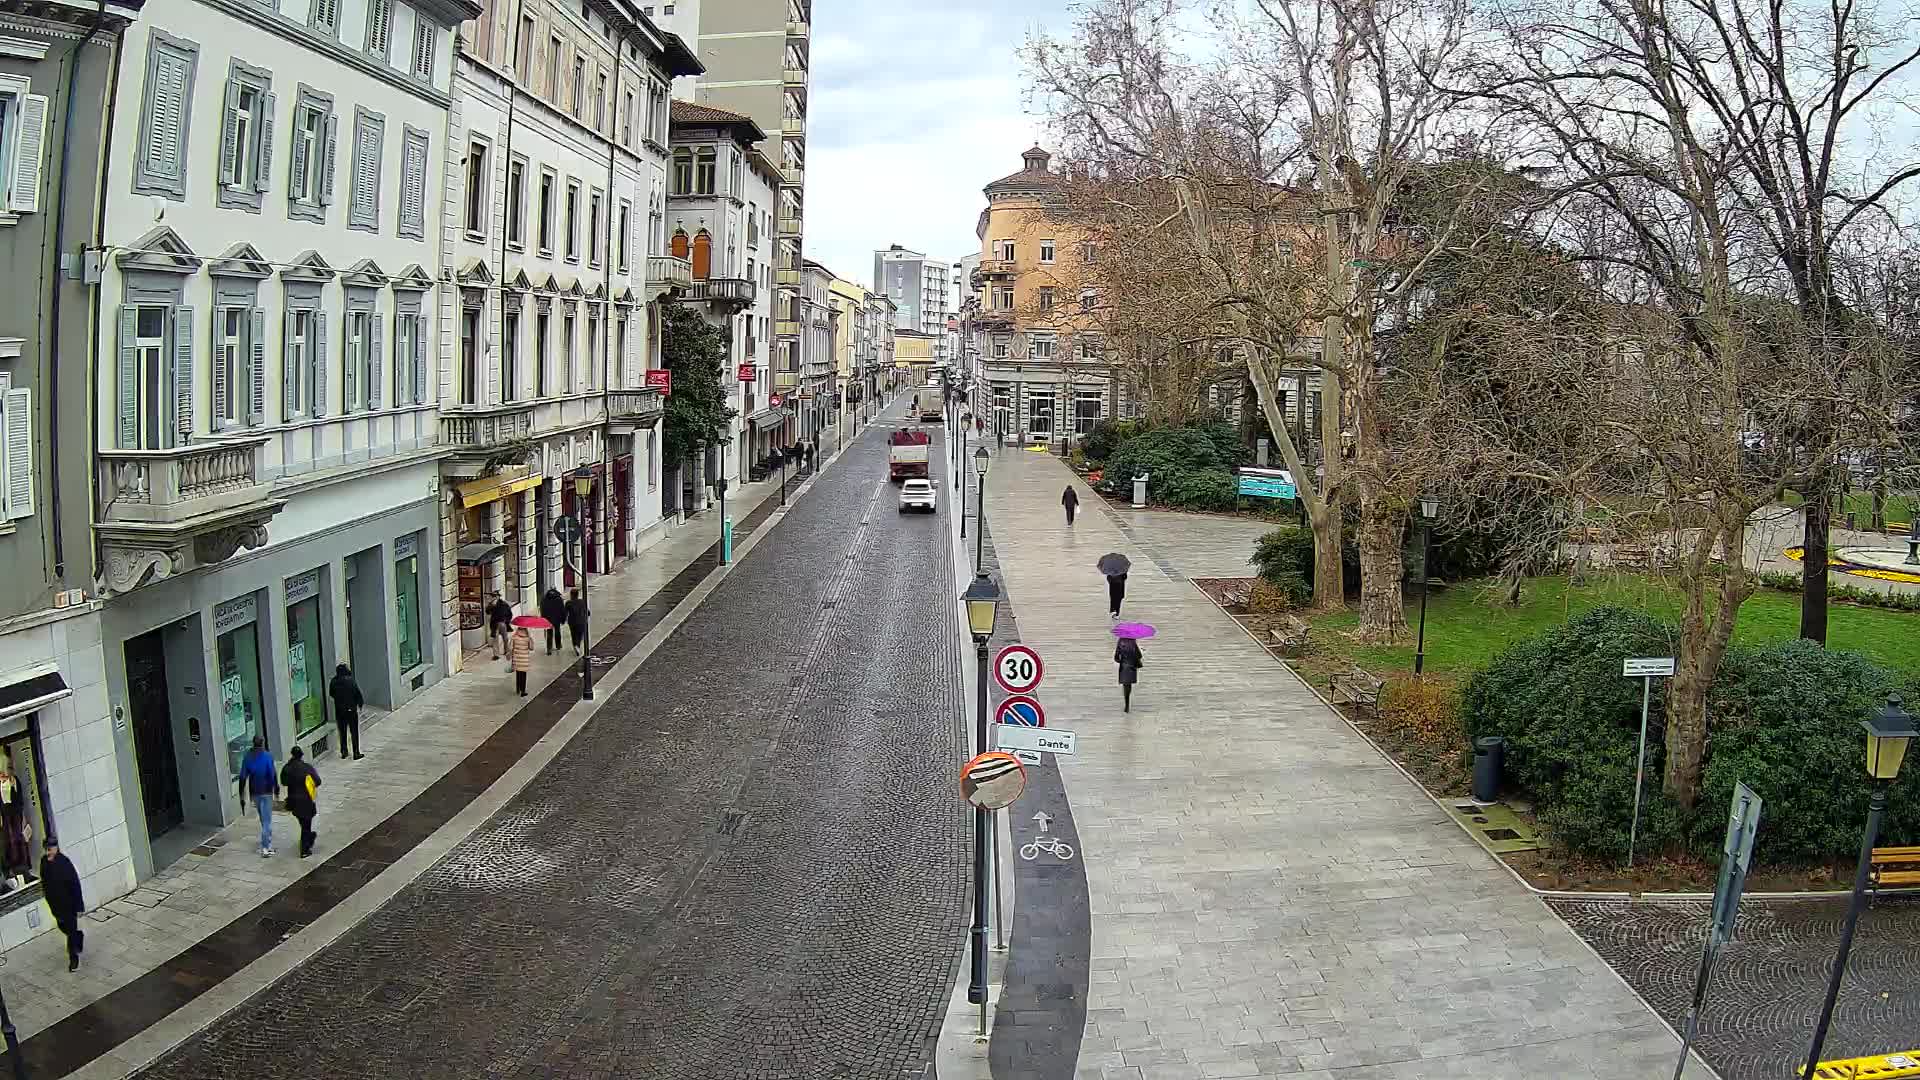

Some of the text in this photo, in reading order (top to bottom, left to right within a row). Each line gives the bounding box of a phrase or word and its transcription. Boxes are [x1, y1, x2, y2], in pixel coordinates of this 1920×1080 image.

[1005, 658, 1033, 680] 30
[222, 677, 241, 700] 130
[1038, 738, 1070, 750] Dante
